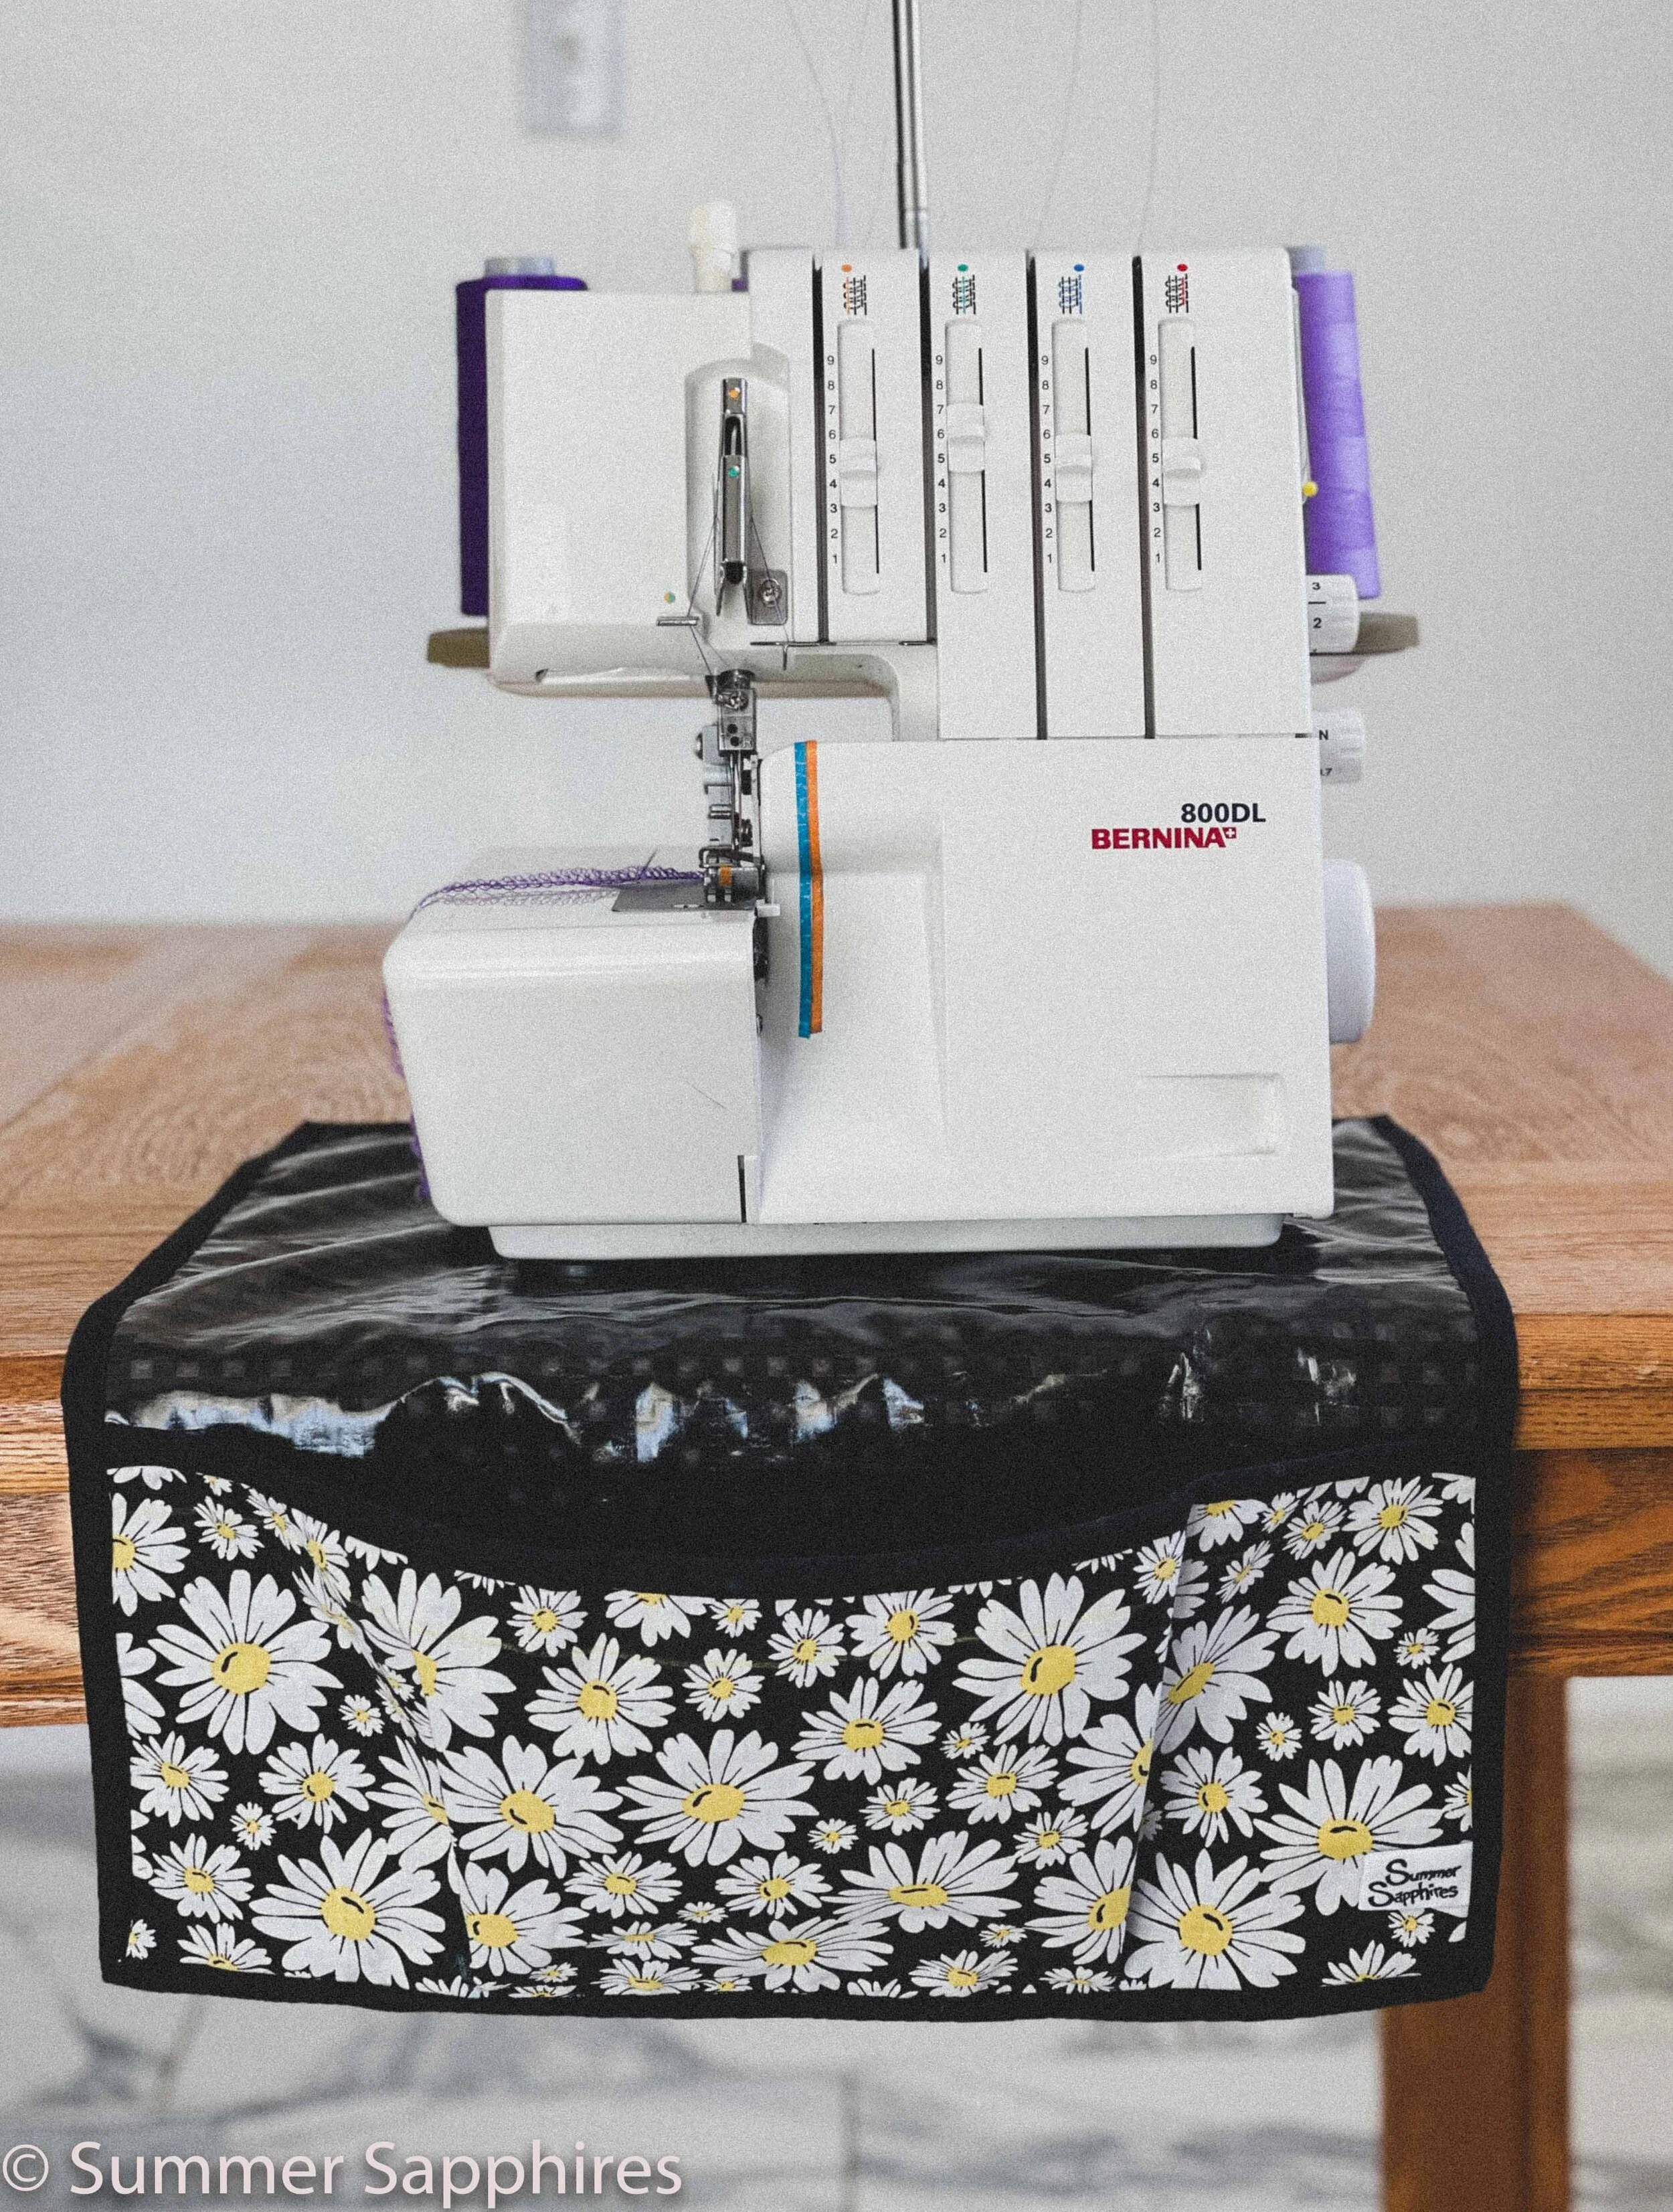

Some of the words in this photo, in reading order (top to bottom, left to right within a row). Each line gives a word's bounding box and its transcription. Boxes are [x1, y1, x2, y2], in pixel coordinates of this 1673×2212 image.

[826, 355, 836, 366] 9
[935, 355, 944, 365] 9
[1041, 355, 1049, 365] 9
[1149, 354, 1158, 365] 9
[826, 379, 836, 391] 8
[936, 379, 944, 390] 8
[1041, 379, 1050, 391] 8
[1150, 379, 1158, 390] 8
[828, 404, 836, 415] 7
[936, 403, 944, 415] 7
[1043, 404, 1051, 415] 7
[1150, 403, 1159, 414] 7
[828, 429, 836, 440] 6
[936, 428, 945, 440] 6
[1042, 429, 1051, 440] 6
[1150, 428, 1159, 439] 6
[828, 454, 837, 464] 5
[938, 452, 946, 464] 5
[1043, 453, 1051, 464] 5
[1152, 452, 1160, 464] 5
[829, 478, 838, 488] 4
[938, 478, 946, 488] 4
[1044, 478, 1052, 488] 4
[1152, 478, 1160, 488] 4
[830, 502, 838, 514] 3
[938, 502, 947, 513] 3
[1045, 502, 1053, 513] 3
[1153, 502, 1161, 513] 3
[831, 528, 839, 539] 2
[939, 527, 947, 539] 2
[1045, 527, 1053, 539] 2
[1153, 527, 1161, 539] 2
[832, 553, 838, 564] 1
[941, 553, 946, 563] 1
[1047, 553, 1053, 563] 1
[1155, 553, 1160, 563] 1
[1312, 581, 1321, 591] 3
[1312, 617, 1322, 629] 2
[1318, 729, 1329, 741] N
[1180, 802, 1267, 823] 800DL
[1091, 827, 1227, 850] BERNINA
[1385, 1858, 1462, 1886] Summer
[1368, 1881, 1459, 1907] Sapphires
